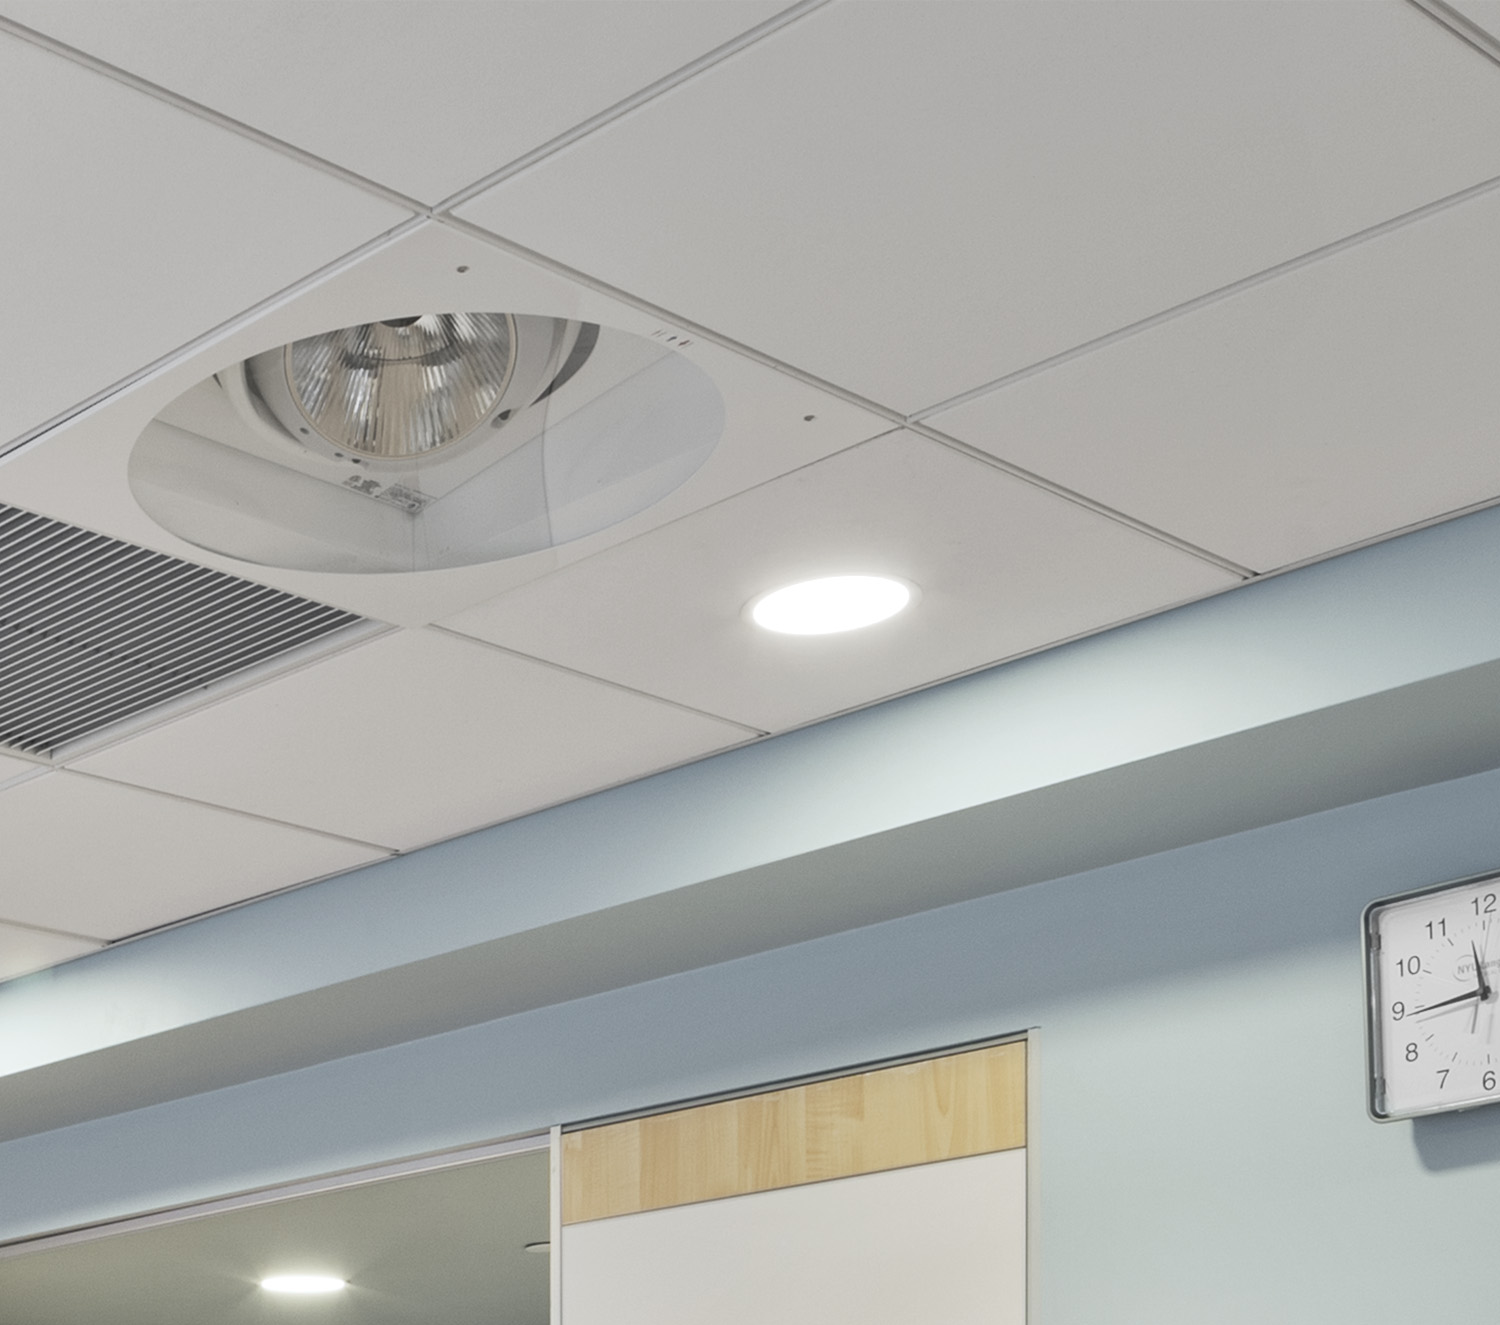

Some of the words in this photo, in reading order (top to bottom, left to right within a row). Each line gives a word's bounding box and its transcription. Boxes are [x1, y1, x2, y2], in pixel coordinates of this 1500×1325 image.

[1470, 893, 1497, 916] 12
[1425, 918, 1447, 939] 11
[1396, 955, 1421, 977] 10
[1391, 1001, 1406, 1021] 9
[1405, 1042, 1419, 1062] 8
[1436, 1069, 1450, 1089] 7
[1482, 1071, 1497, 1091] 6
